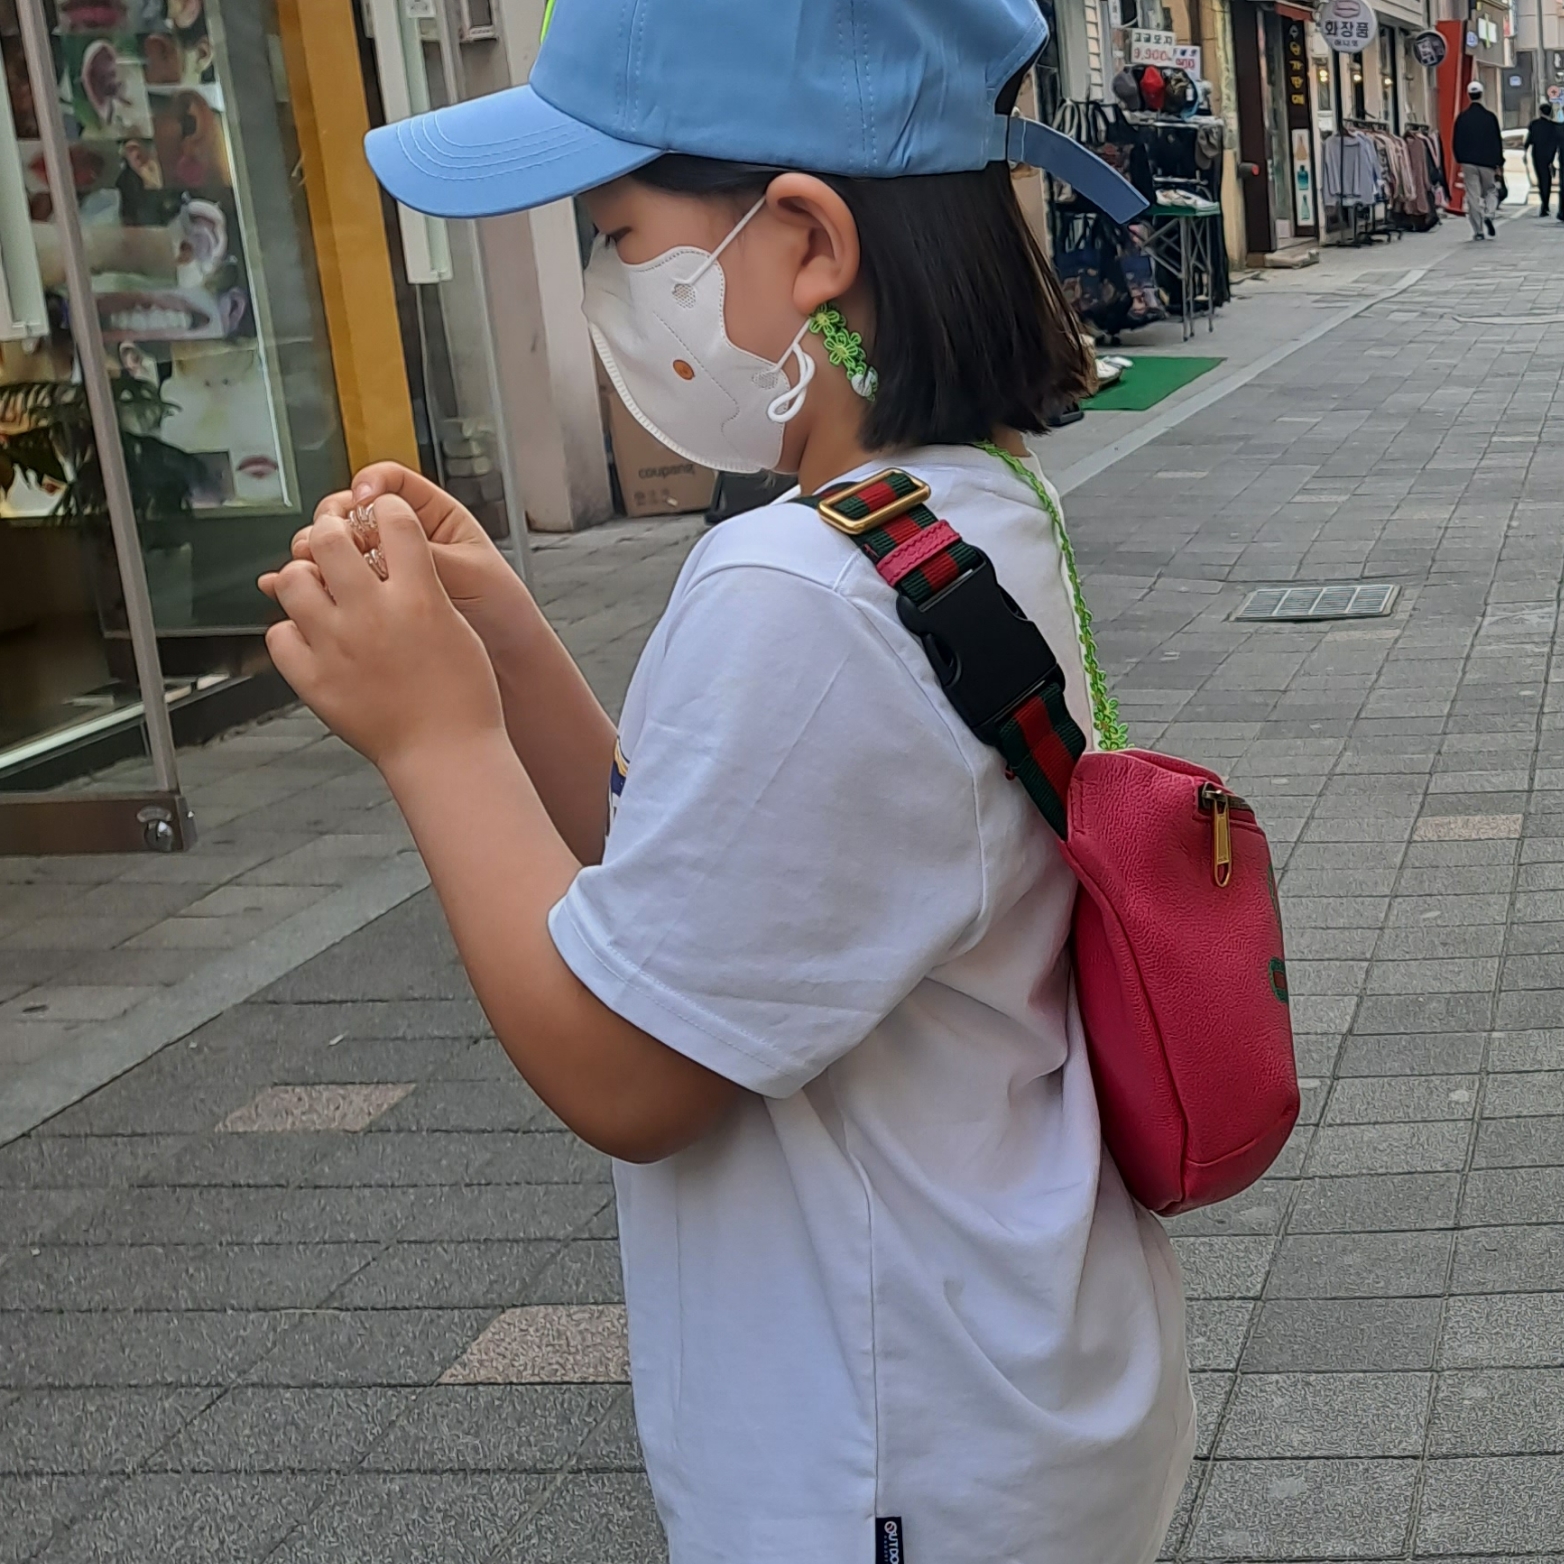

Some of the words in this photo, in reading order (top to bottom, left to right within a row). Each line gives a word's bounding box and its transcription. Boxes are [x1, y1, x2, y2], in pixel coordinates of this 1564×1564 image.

[1325, 20, 1369, 39] 화장품
[1134, 32, 1173, 45] 고급모자
[638, 463, 696, 480] coupang
